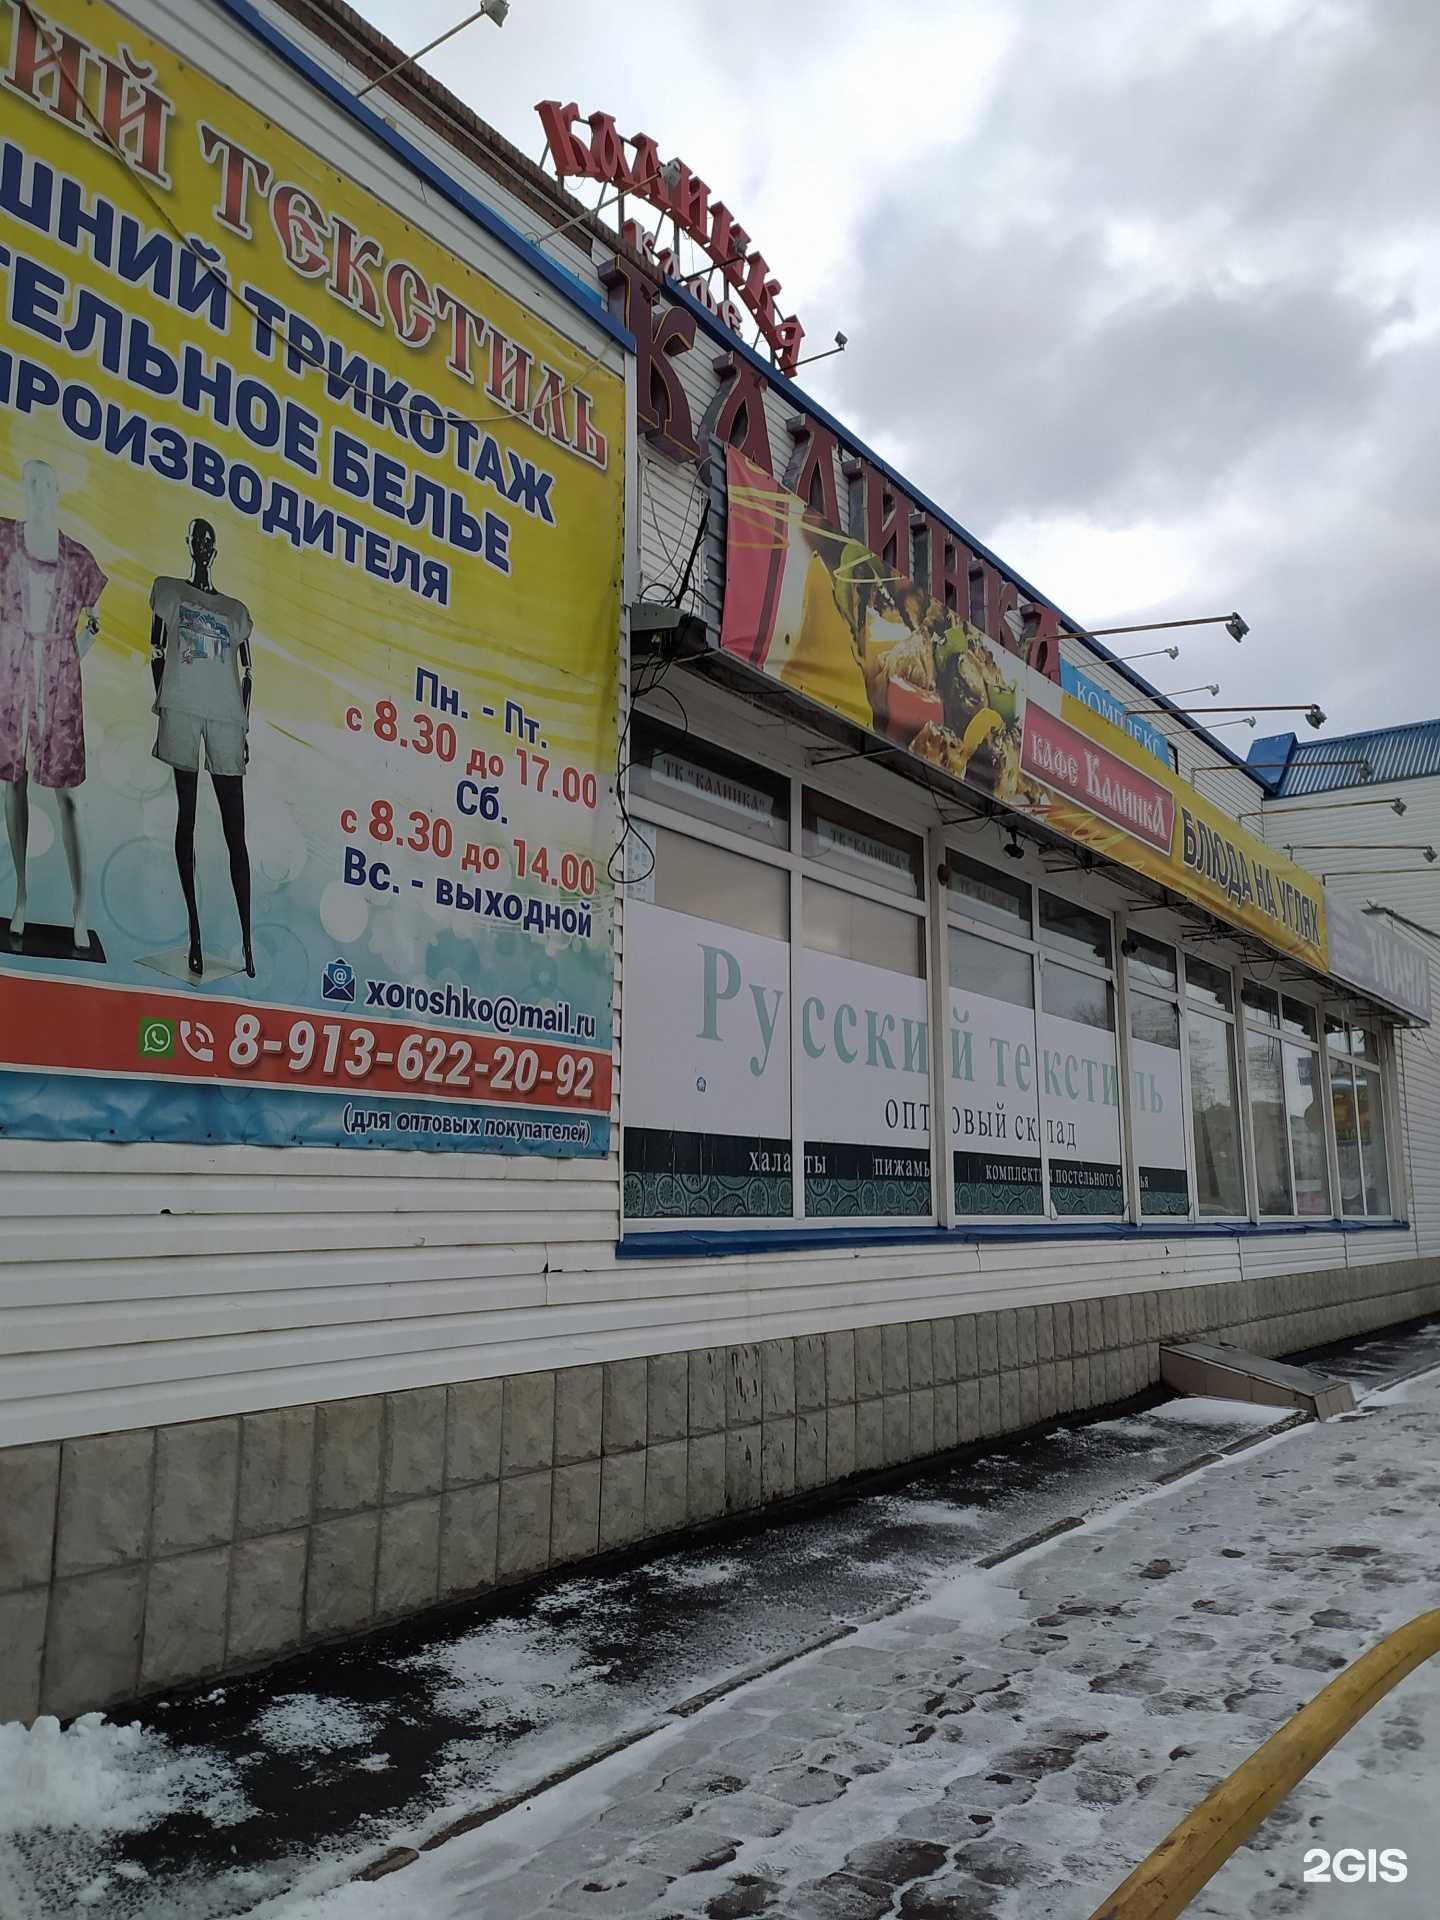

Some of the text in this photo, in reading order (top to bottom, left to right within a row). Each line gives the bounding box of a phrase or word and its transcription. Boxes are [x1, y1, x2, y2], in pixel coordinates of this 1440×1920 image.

[200, 122, 608, 470] ТЕКСТИЛЬ
[0, 246, 510, 572] ЕЛЬНОЕ БЕЛЬЕ
[245, 291, 556, 523] ТРИКОТАЖ
[598, 254, 1061, 686] КАЛИНКА
[346, 700, 597, 808] с 8.30 до 17.00
[415, 667, 469, 719] Пн.
[505, 700, 548, 749] Пт.
[341, 809, 357, 833] с
[369, 800, 453, 858] 8.30
[461, 843, 500, 873] до
[513, 839, 596, 895] 14.00
[456, 780, 508, 824] Сб.
[343, 846, 400, 893] Вс.
[436, 878, 592, 938] выходной
[1181, 804, 1321, 949] БЛЮДА НА УГЛЯХ
[228, 1014, 595, 1098] 8-913-622-20-92
[366, 979, 596, 1038] xoroshko@mail.ru
[696, 943, 1164, 1114] Русский текстиль
[343, 1103, 592, 1146] (для оптовых покупателей)
[750, 1151, 826, 1175] халаты
[1055, 1168, 1115, 1188] постельного
